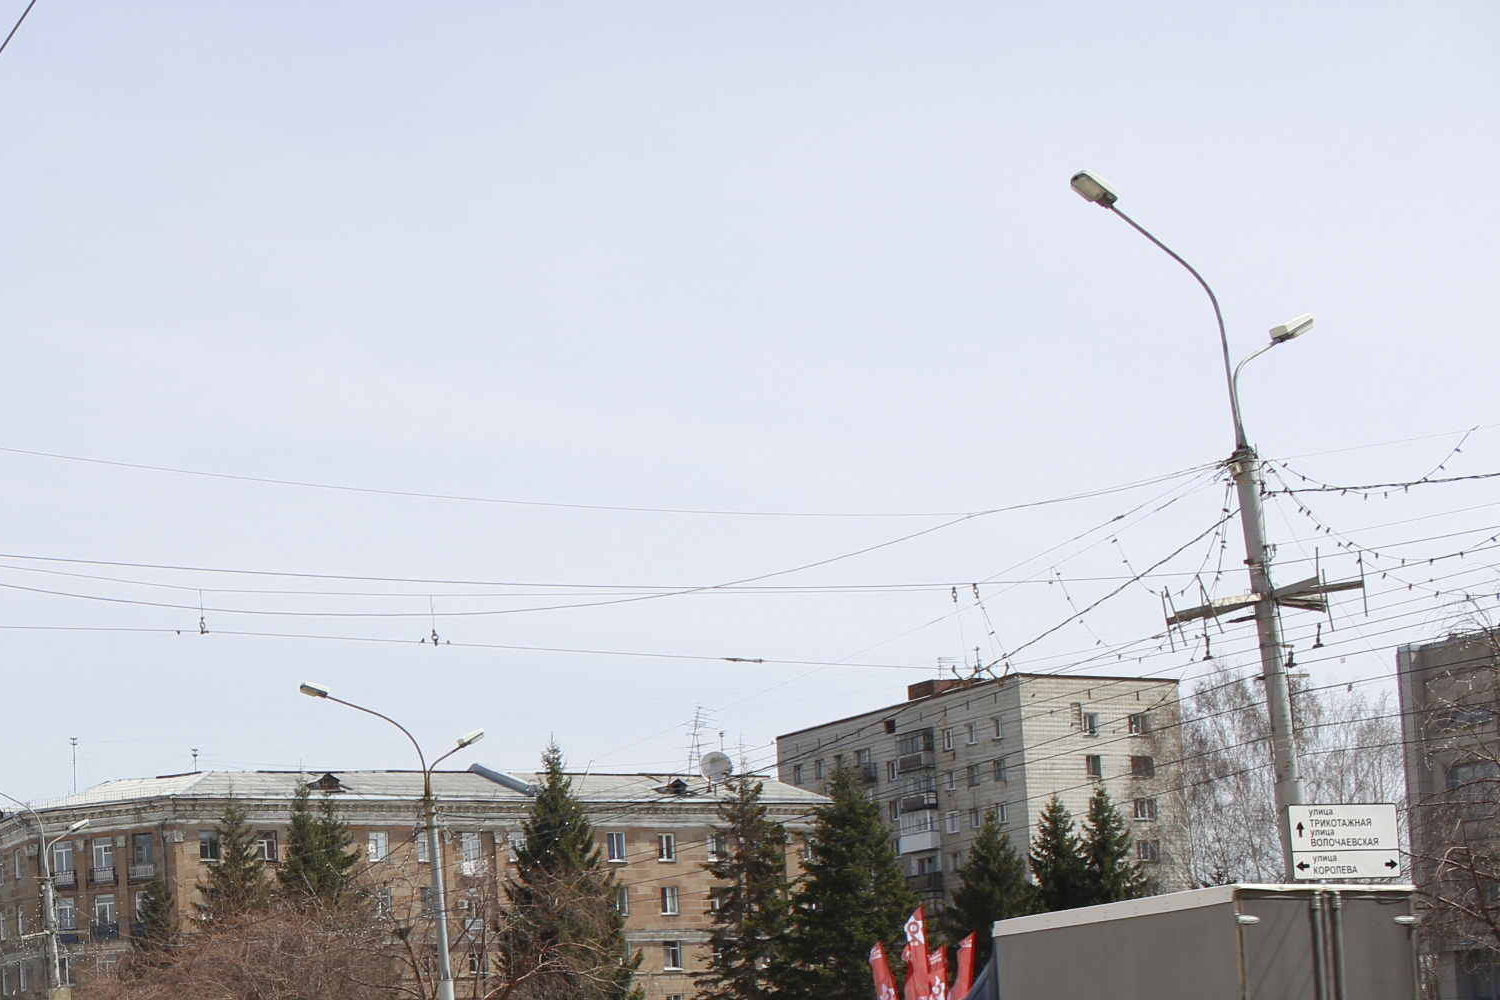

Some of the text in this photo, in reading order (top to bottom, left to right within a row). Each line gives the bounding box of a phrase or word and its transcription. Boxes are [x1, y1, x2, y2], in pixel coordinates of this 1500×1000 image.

[1308, 808, 1334, 818] улица
[1309, 818, 1372, 828] ТРИКОТАЖНАЯ
[1310, 829, 1335, 838] улица
[1310, 838, 1379, 847] ВОЛОЧАЕВСКАЯ
[1312, 855, 1337, 864] улица
[1313, 866, 1358, 875] КОРОЛЕВА
